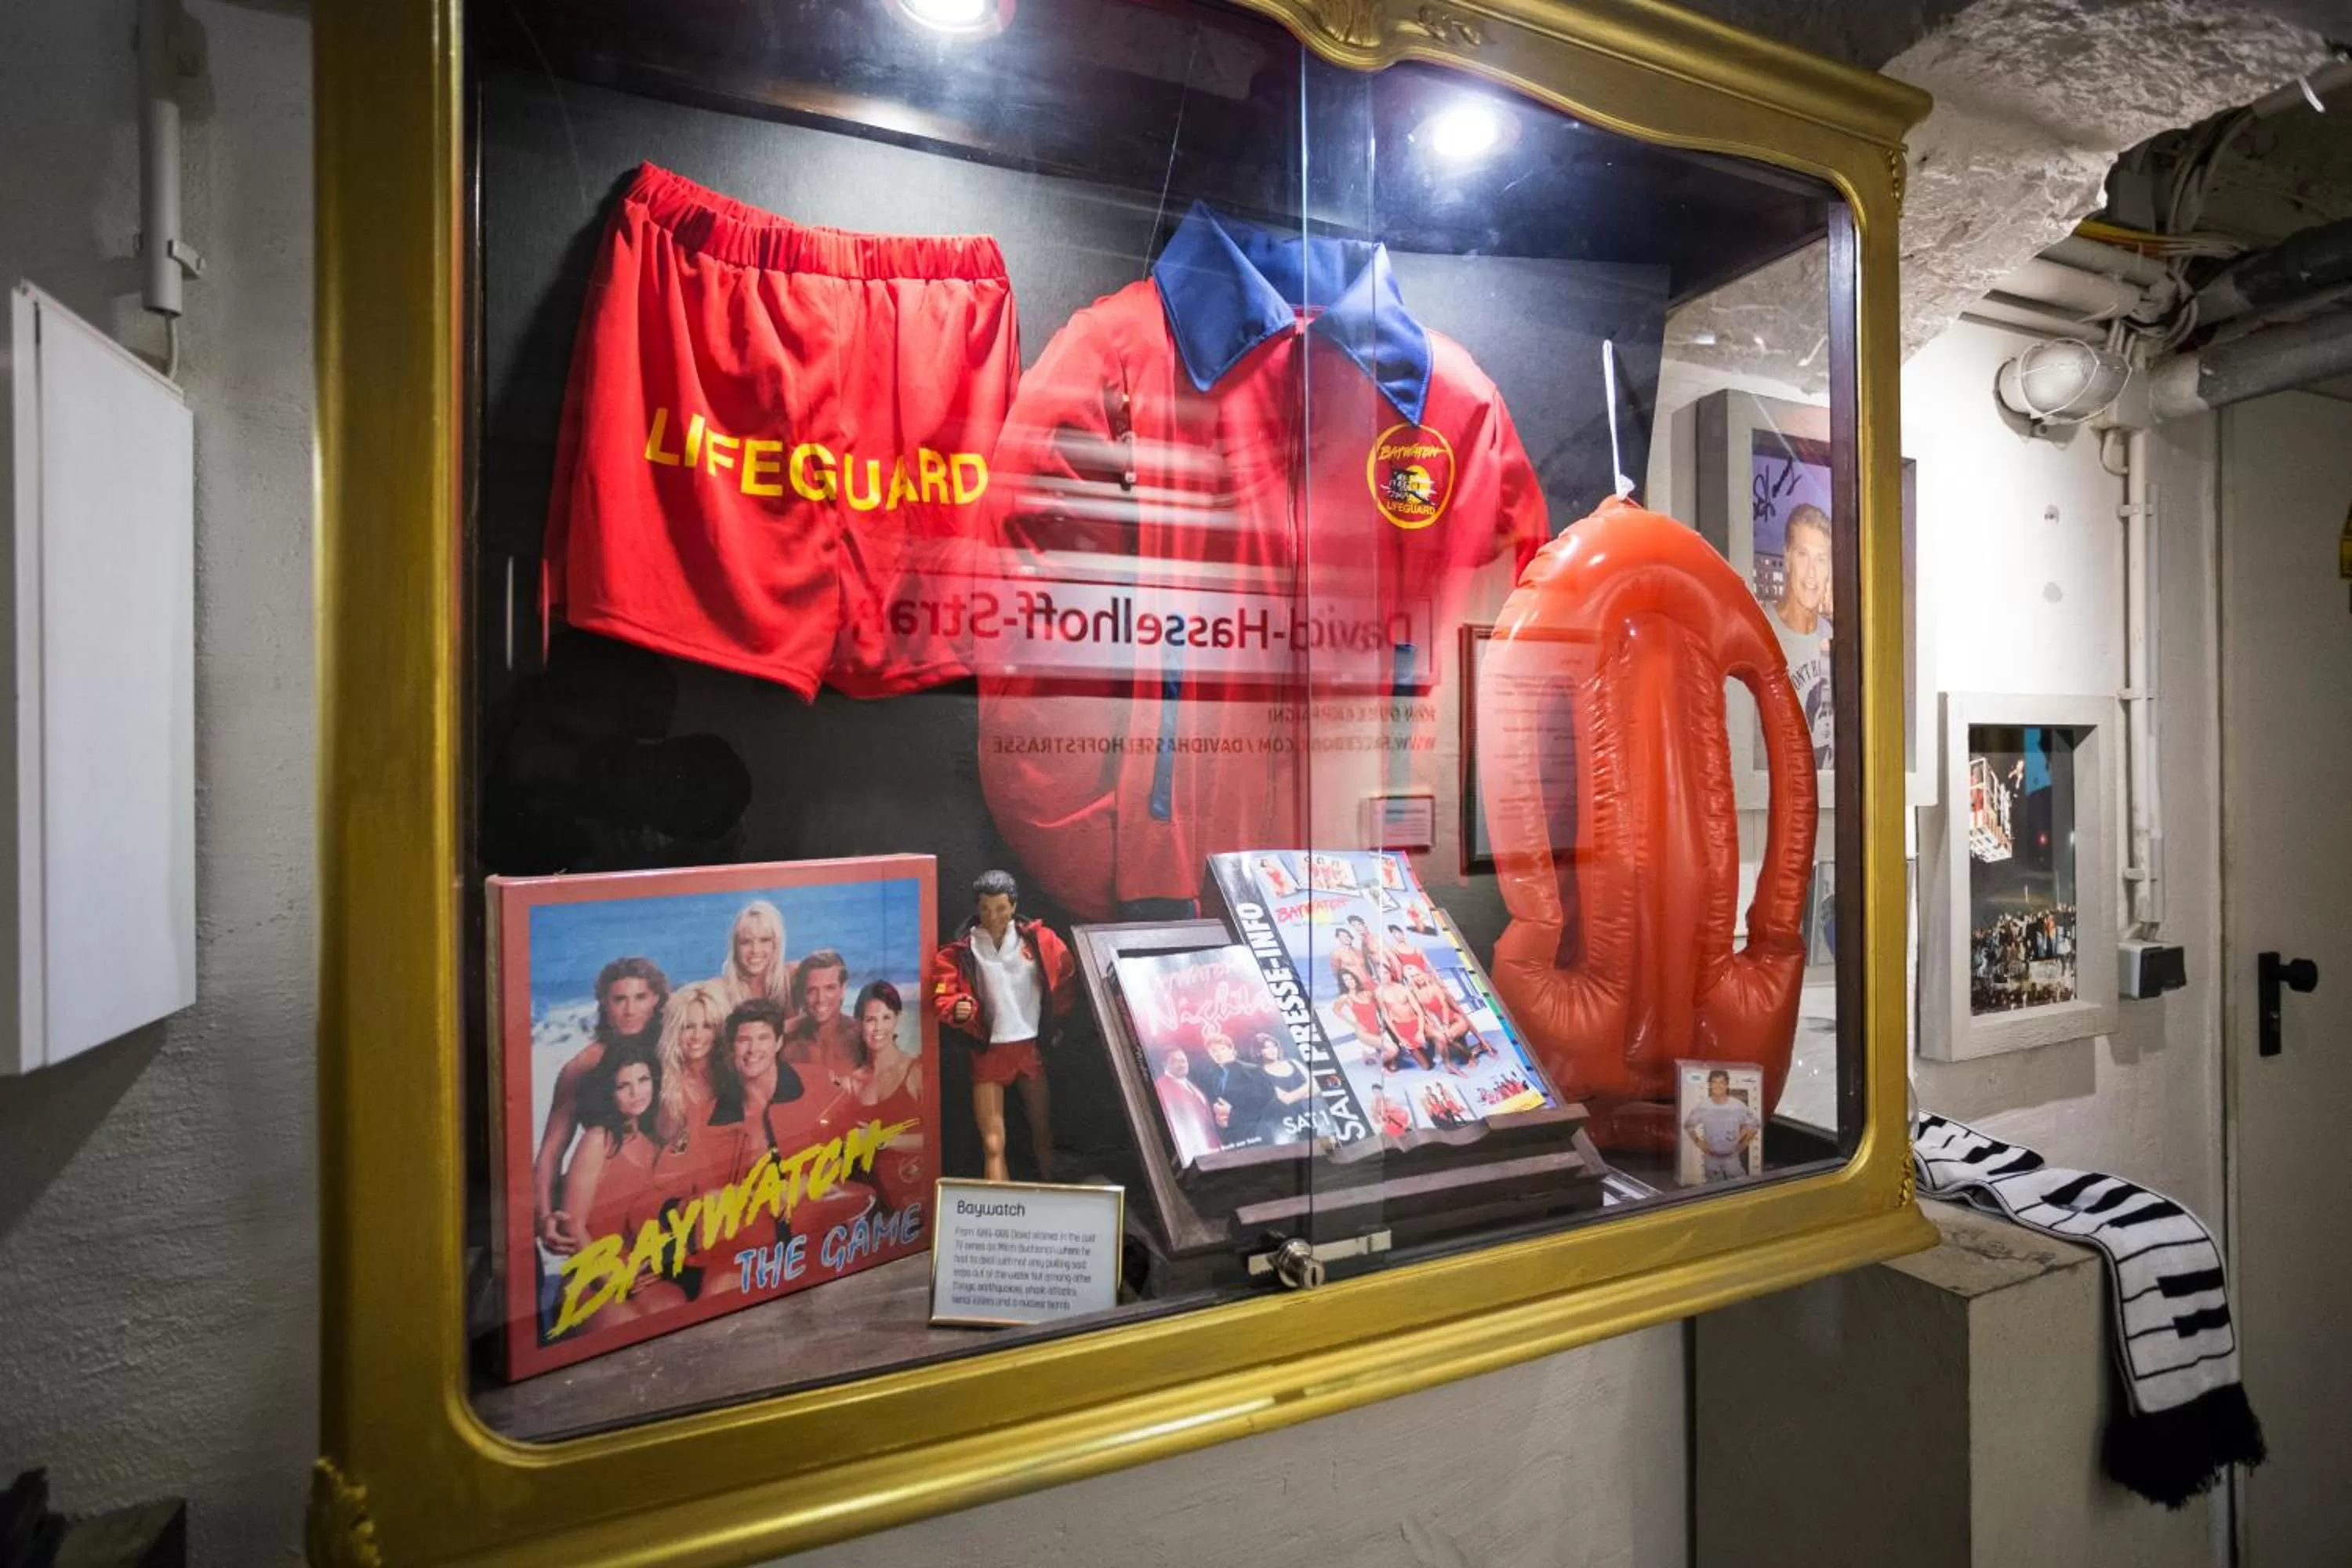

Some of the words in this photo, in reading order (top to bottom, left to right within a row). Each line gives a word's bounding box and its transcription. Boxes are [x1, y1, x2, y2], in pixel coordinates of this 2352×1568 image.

[644, 408, 989, 511] LIFEGUARD
[1387, 501, 1436, 515] LIFEGUARD
[549, 1118, 921, 1339] BAYWATCH
[735, 1234, 808, 1294] THE
[821, 1203, 922, 1272] GAME
[957, 1200, 1025, 1217] Baywatch
